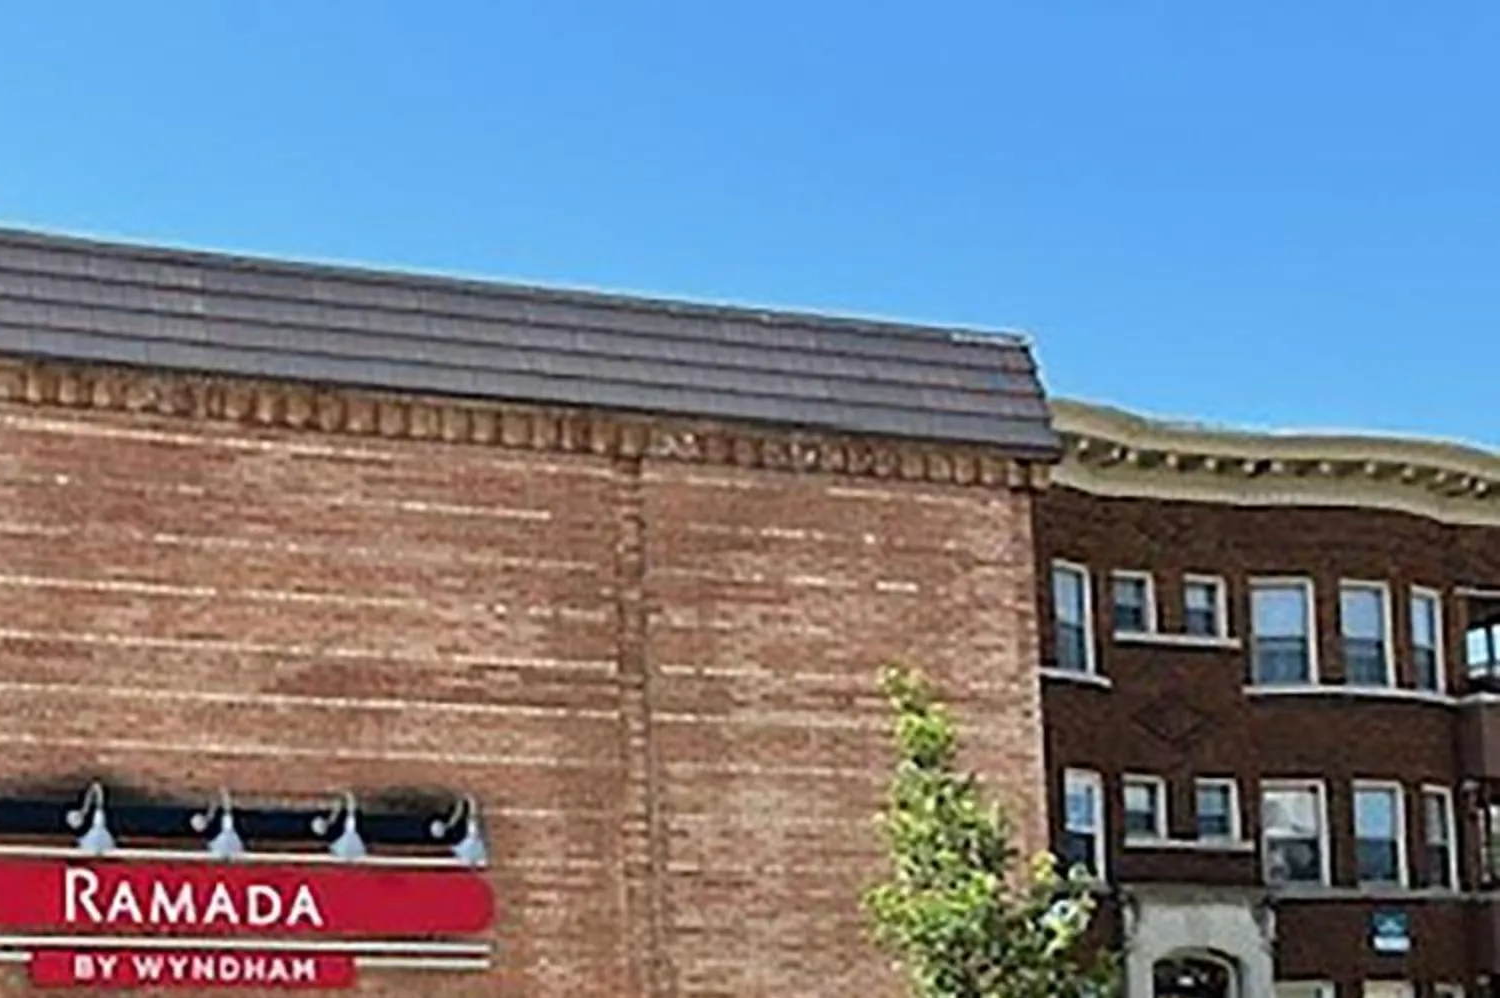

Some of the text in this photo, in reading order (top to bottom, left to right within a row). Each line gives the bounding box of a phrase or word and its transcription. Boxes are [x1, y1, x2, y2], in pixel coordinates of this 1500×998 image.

[65, 867, 324, 927] RAMADA
[74, 954, 316, 982] BY WYNDHAM
